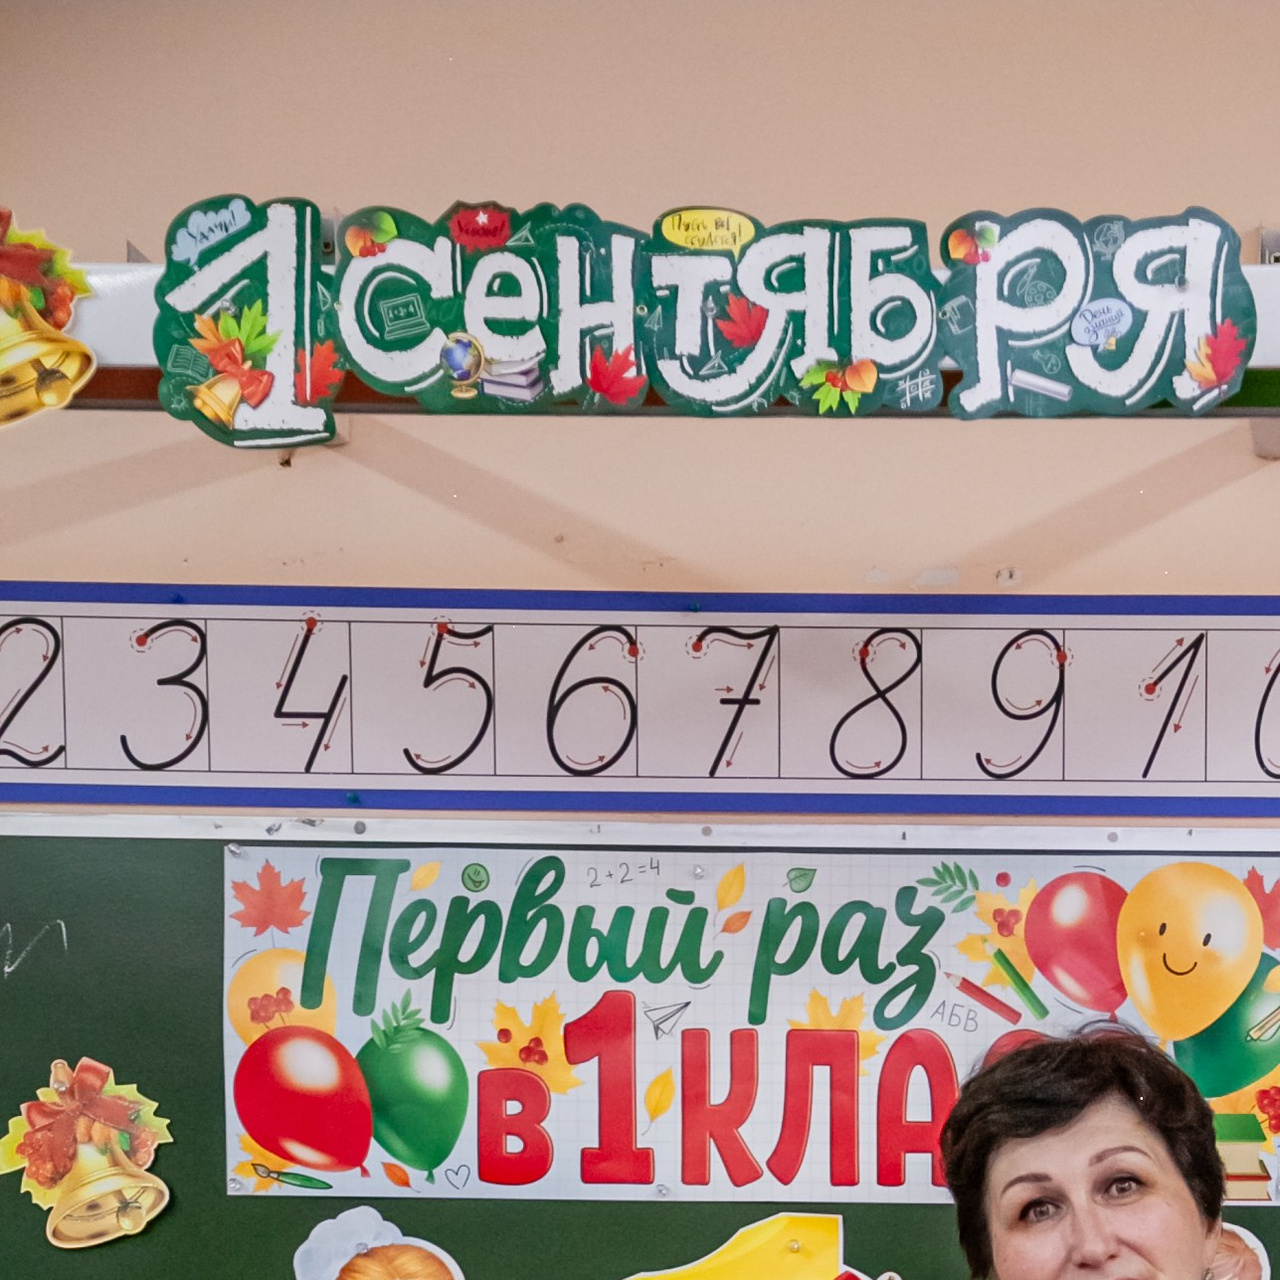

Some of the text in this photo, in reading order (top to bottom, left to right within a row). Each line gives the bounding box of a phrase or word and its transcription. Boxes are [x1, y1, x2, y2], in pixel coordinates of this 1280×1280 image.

[165, 203, 332, 433] 1
[300, 855, 946, 1030] Первый раз
[930, 1000, 978, 1033] АБВ
[680, 1027, 1140, 1188] КЛА
